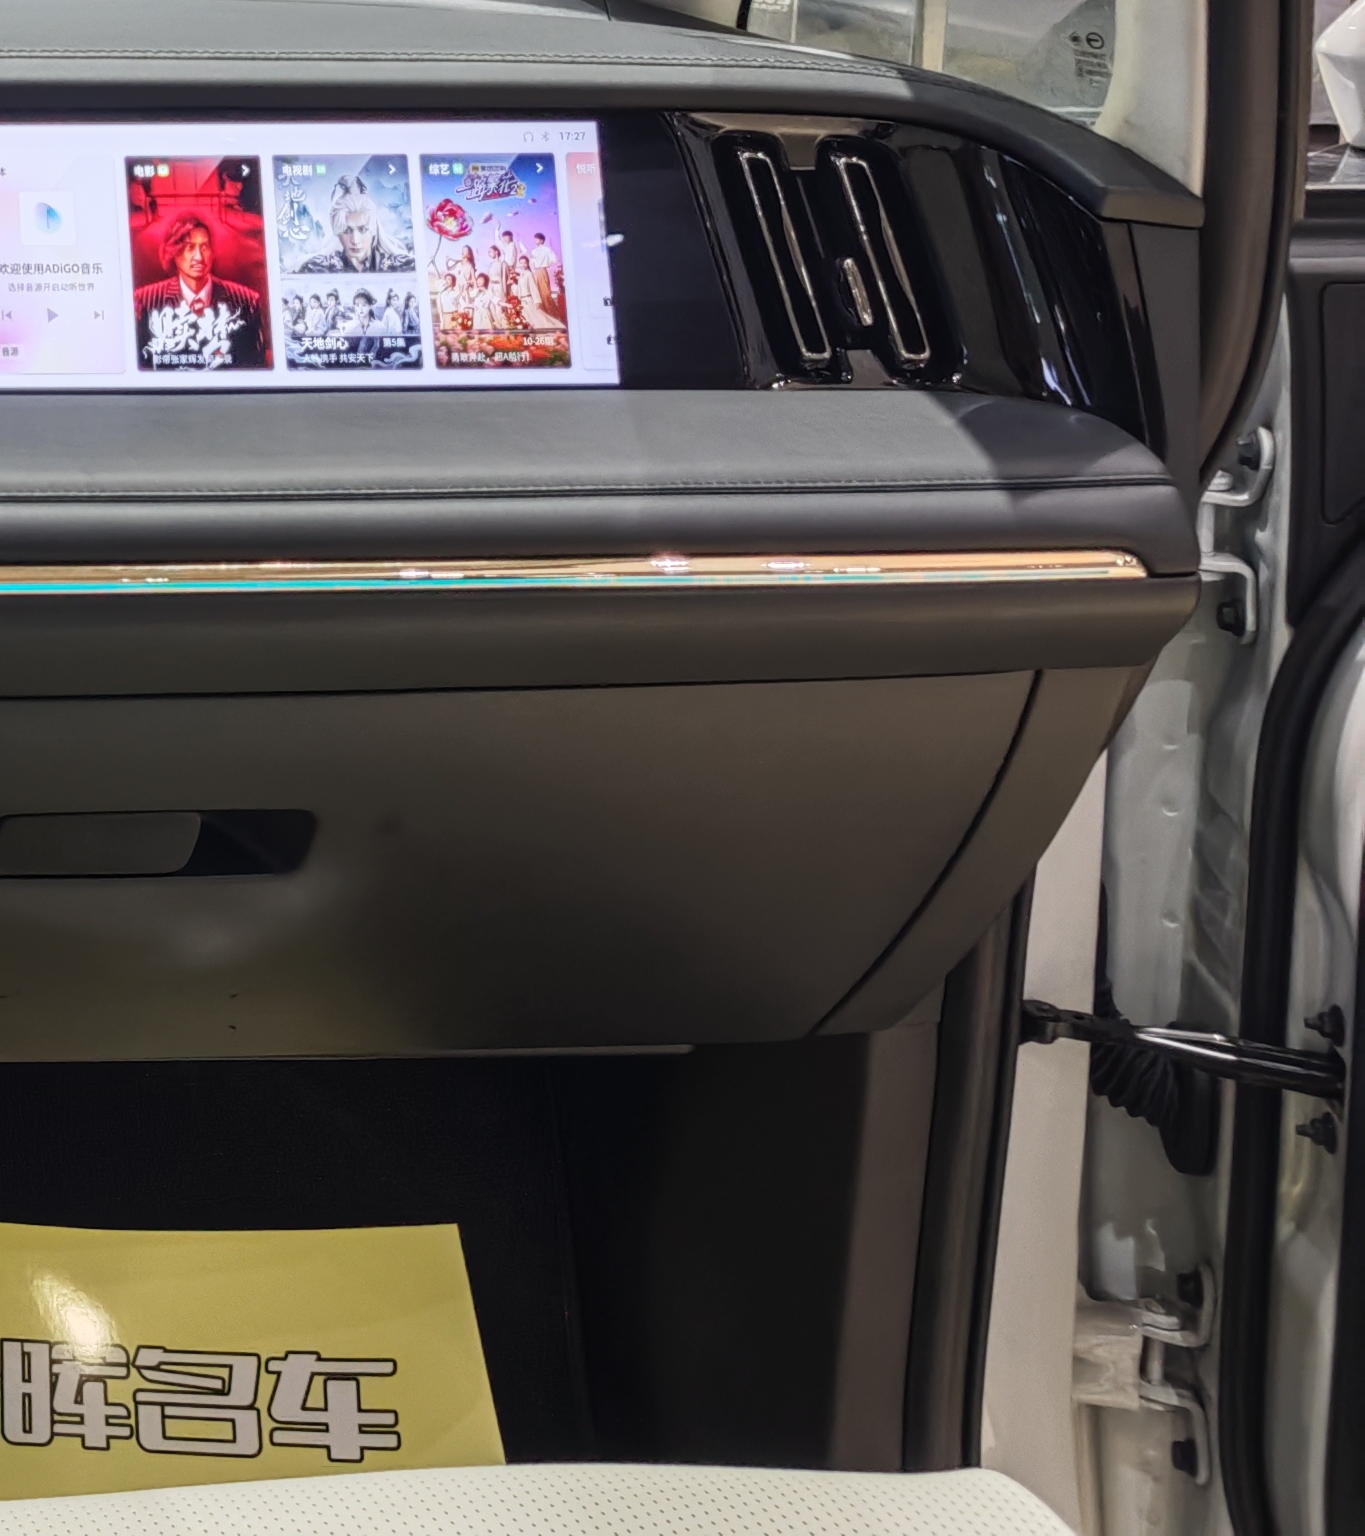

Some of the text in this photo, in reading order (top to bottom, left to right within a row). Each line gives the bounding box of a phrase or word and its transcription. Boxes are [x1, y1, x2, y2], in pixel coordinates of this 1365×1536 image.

[559, 132, 586, 141] 17:27
[282, 164, 313, 176] 电视剧
[429, 164, 450, 175] 综艺
[301, 337, 348, 350] 天地剑心
[2, 346, 19, 356] 音源
